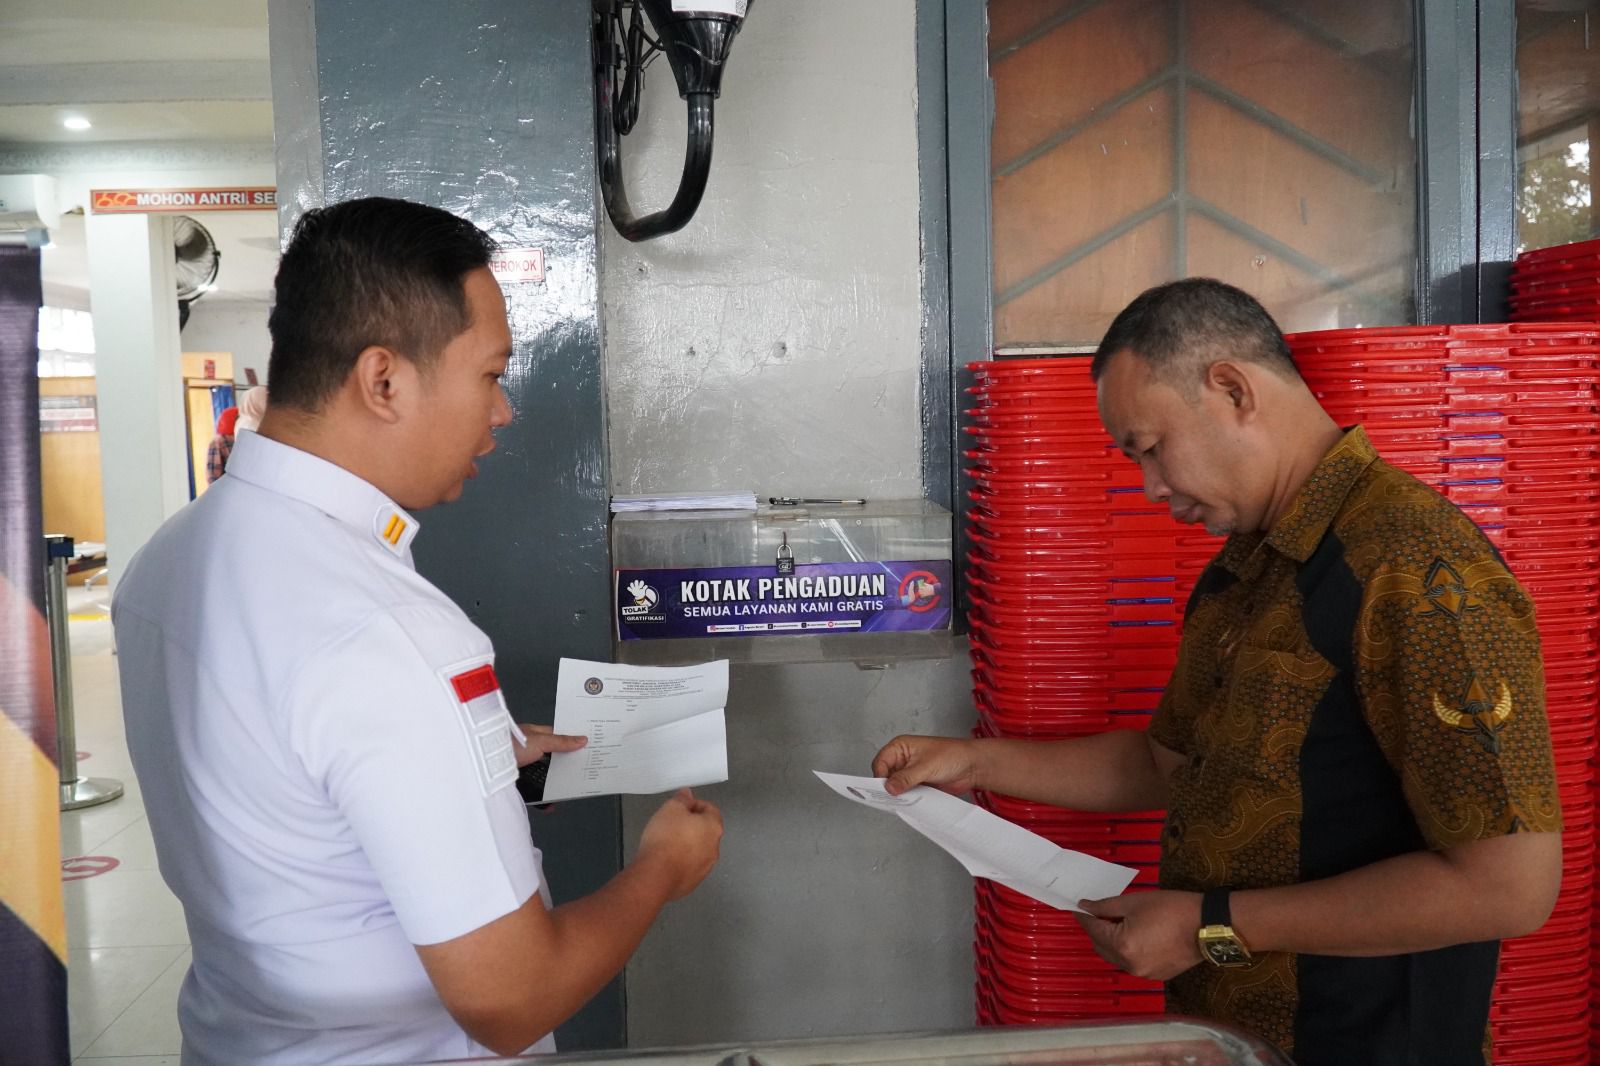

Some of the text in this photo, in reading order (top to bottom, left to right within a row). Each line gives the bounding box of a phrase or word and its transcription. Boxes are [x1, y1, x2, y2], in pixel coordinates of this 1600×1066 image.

[136, 193, 196, 206] MOHON
[253, 192, 277, 204] SE
[681, 574, 885, 603] KOTAK PENGADUAN
[683, 600, 884, 618] SEMUA LAYANAN KAMI GRATIS
